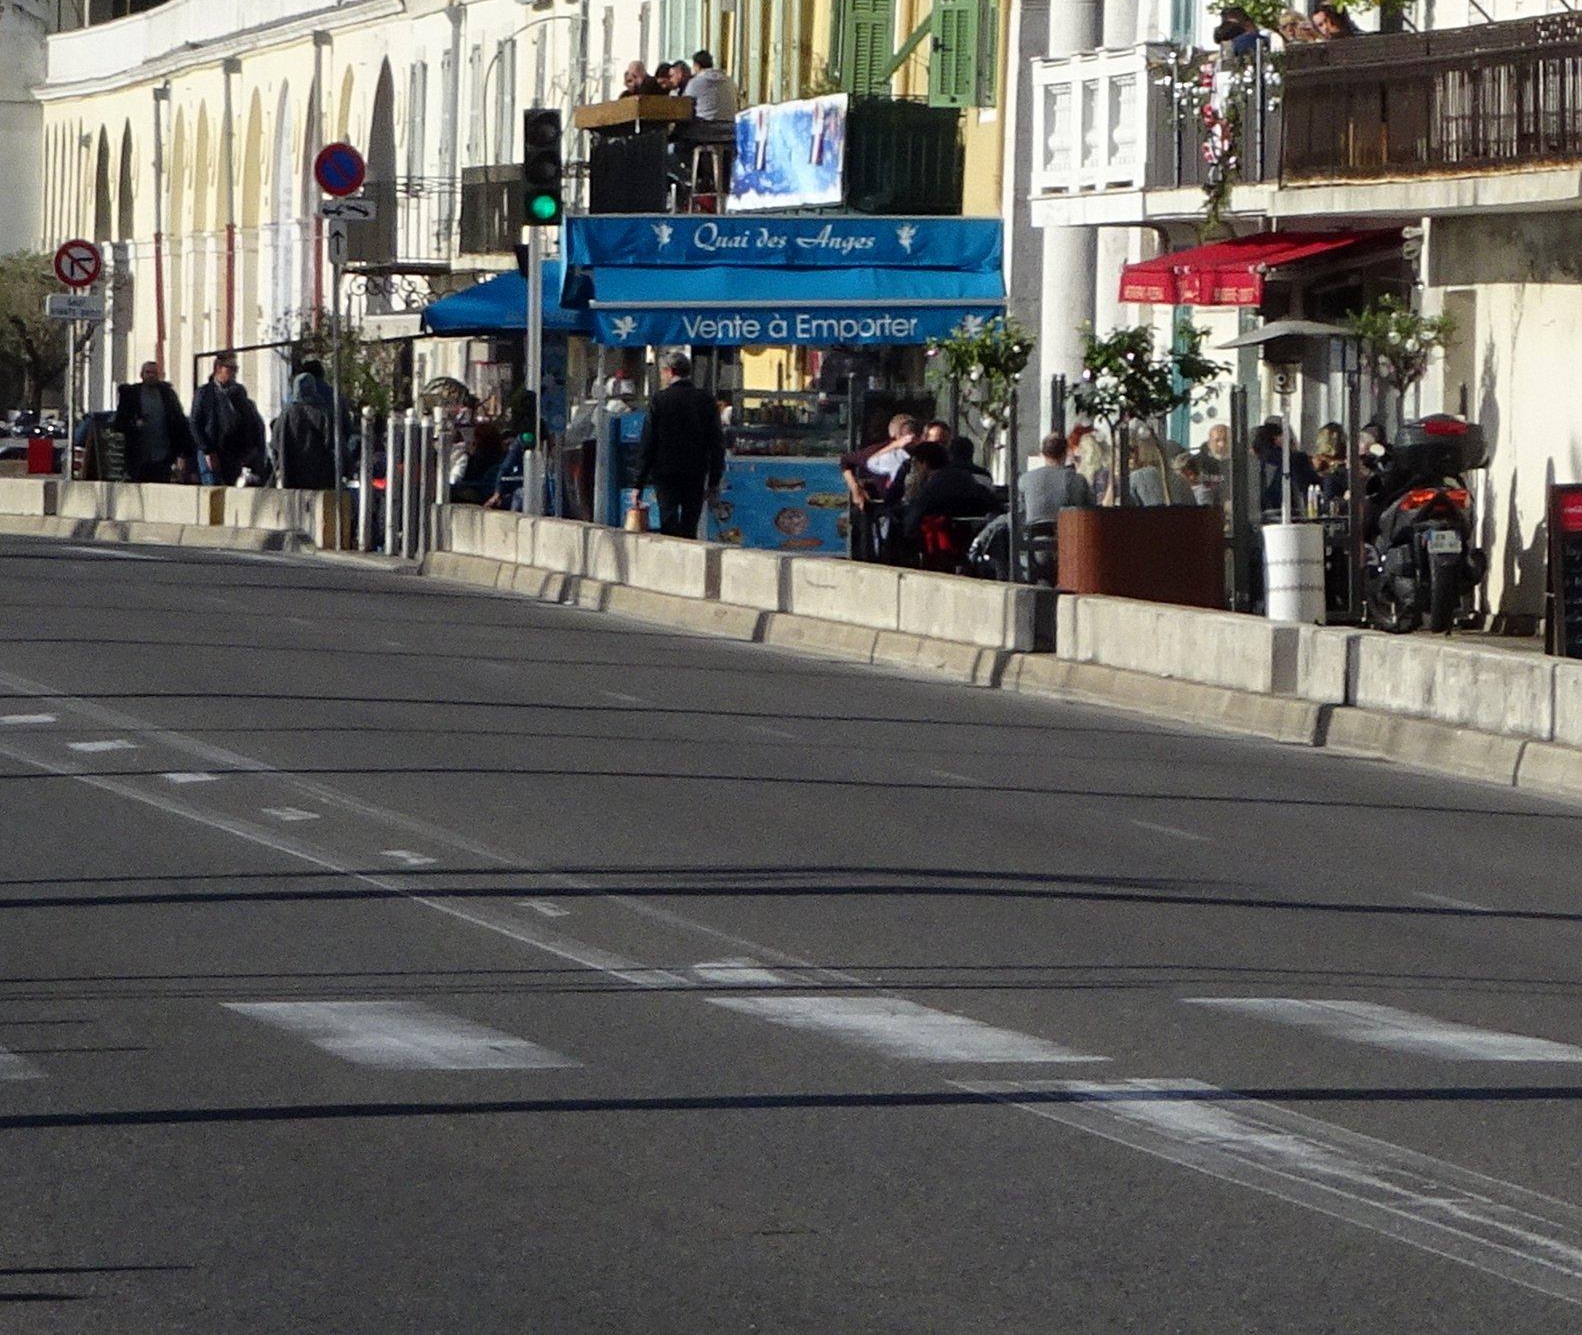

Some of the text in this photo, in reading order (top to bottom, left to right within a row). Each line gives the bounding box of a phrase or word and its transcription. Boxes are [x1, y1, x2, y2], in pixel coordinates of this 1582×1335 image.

[694, 222, 876, 255] Quai des Anges
[683, 313, 919, 342] Vente à Emporter
